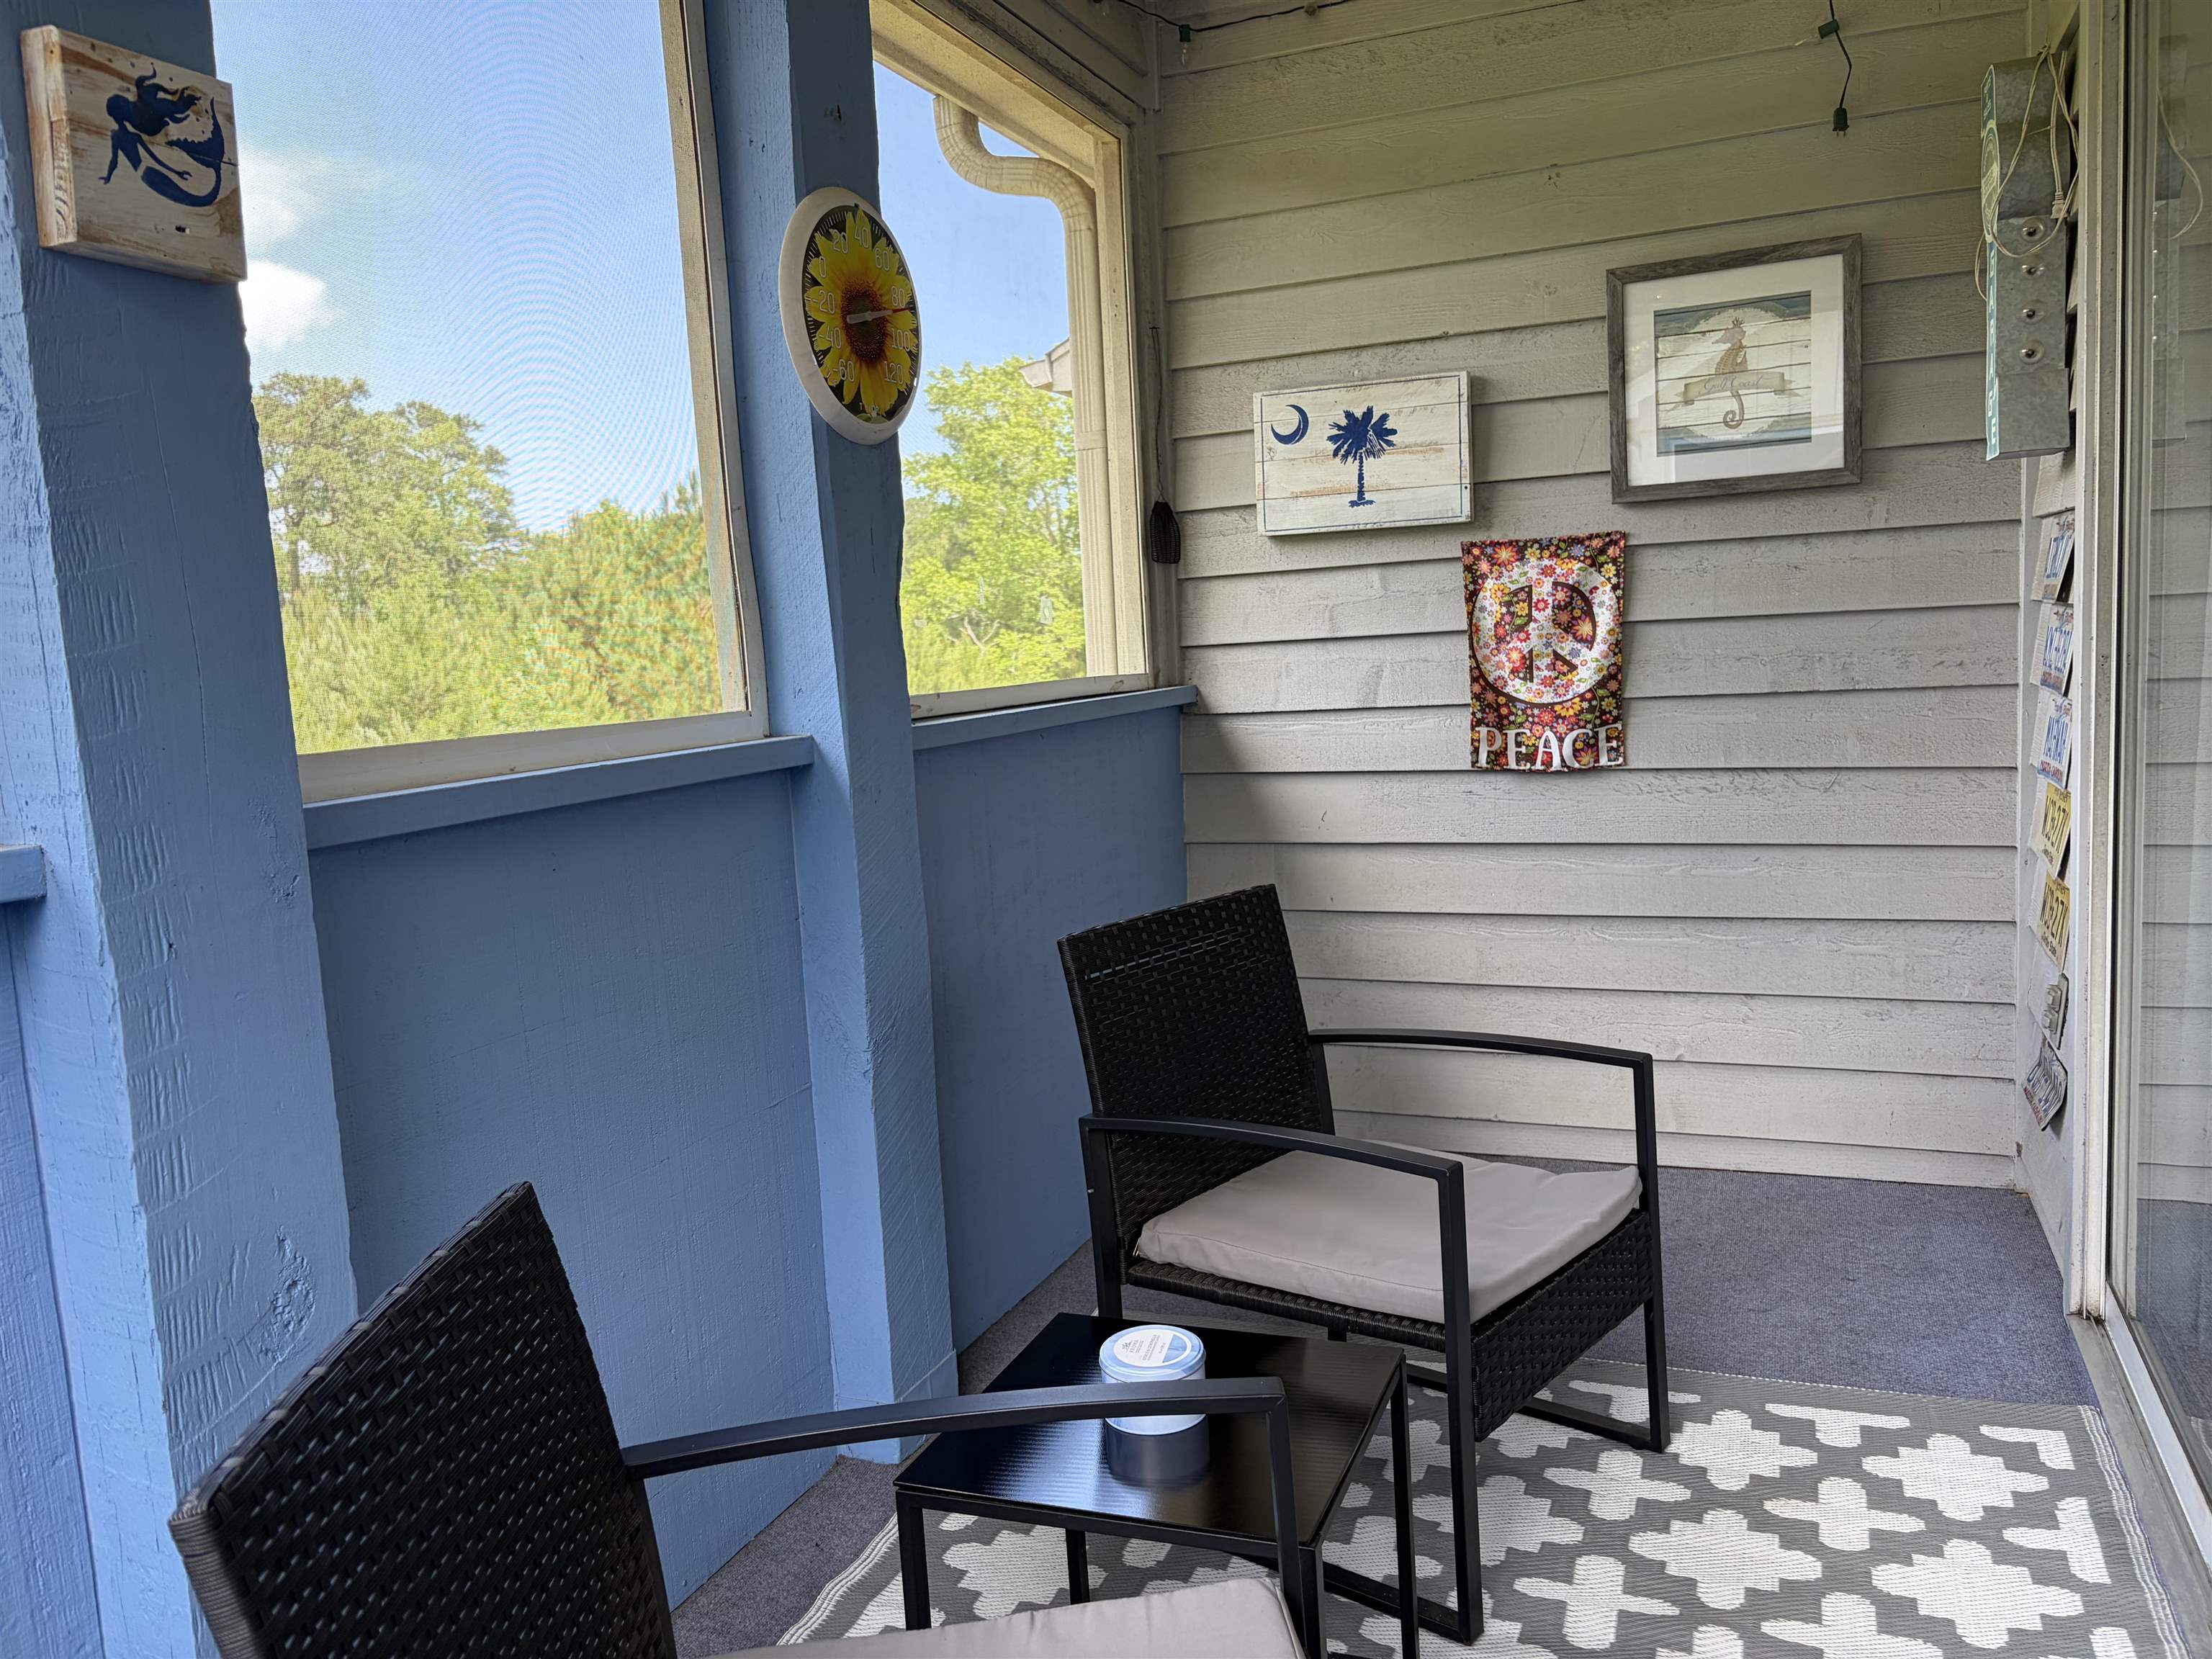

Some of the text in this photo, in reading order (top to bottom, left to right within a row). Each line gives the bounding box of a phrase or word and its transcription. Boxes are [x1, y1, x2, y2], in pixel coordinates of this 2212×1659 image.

[832, 229, 848, 254] 20
[854, 226, 870, 249] 40
[818, 256, 827, 279] 0
[875, 247, 891, 271] 60
[891, 285, 905, 307] 80
[891, 327, 911, 352] 100
[884, 361, 904, 385] 120
[1475, 723, 1623, 771] PEACE
